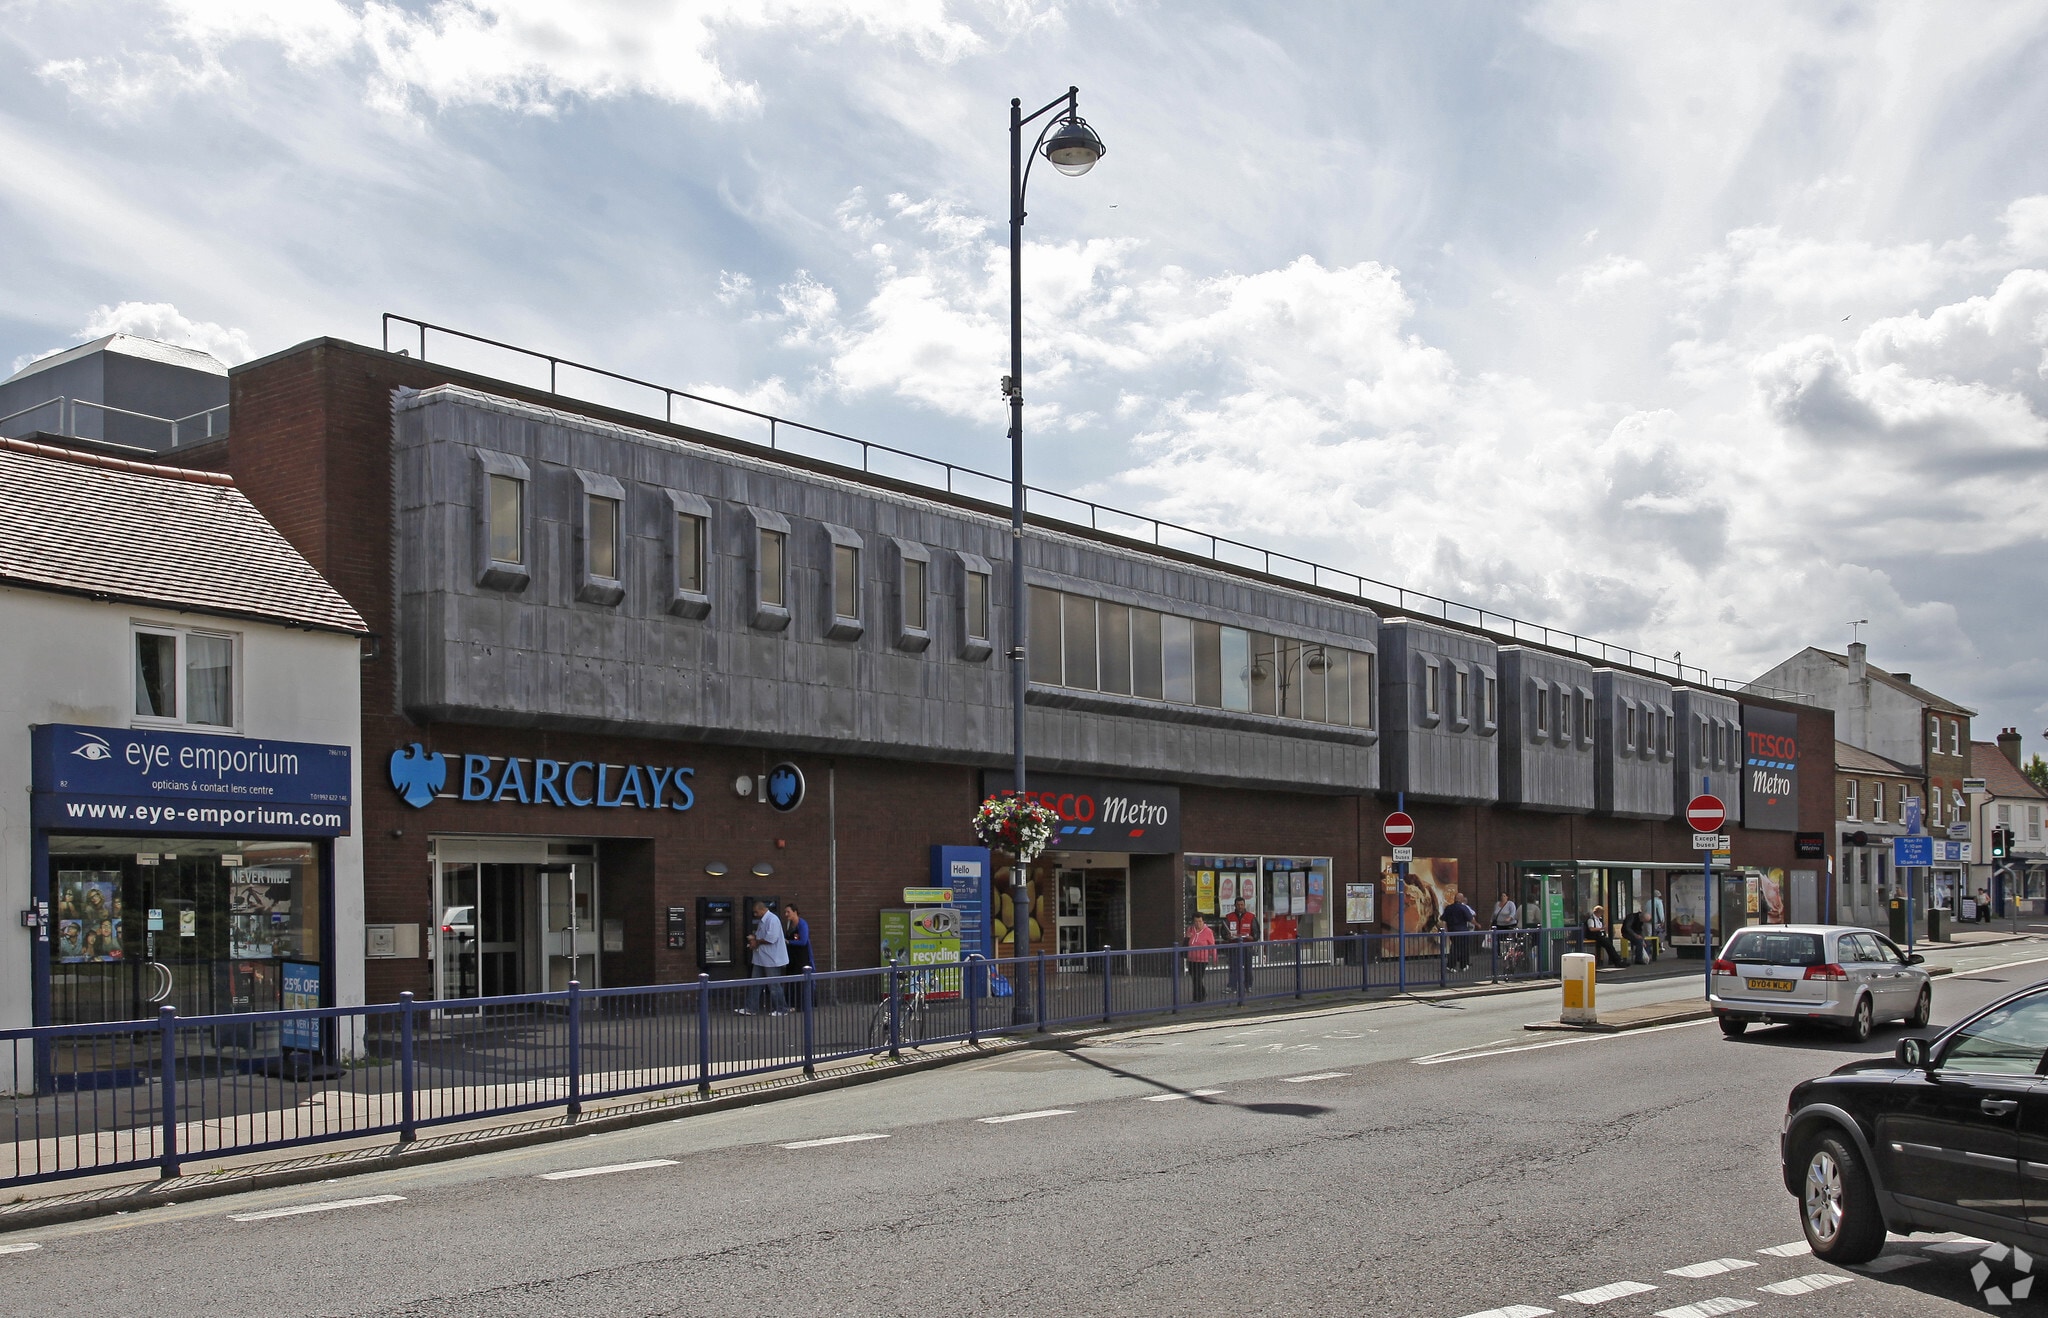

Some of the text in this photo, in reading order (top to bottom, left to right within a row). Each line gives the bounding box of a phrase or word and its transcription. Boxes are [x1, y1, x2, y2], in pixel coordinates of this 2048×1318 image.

[1747, 731, 1796, 760] TESCO
[125, 742, 299, 779] eye emporium
[60, 780, 69, 788] 82
[152, 780, 274, 795] opticians & contact lens centre
[462, 754, 694, 811] BARCLAYS
[1752, 770, 1791, 796] Metro
[66, 803, 342, 827] www.eye-emporium.com
[1103, 796, 1168, 826] Metro
[231, 869, 290, 884] NEVER HIDE
[953, 865, 970, 874] Hello
[913, 947, 960, 965] recycling
[284, 978, 319, 993] 25% OFF
[1751, 980, 1789, 989] DY04 WLK
